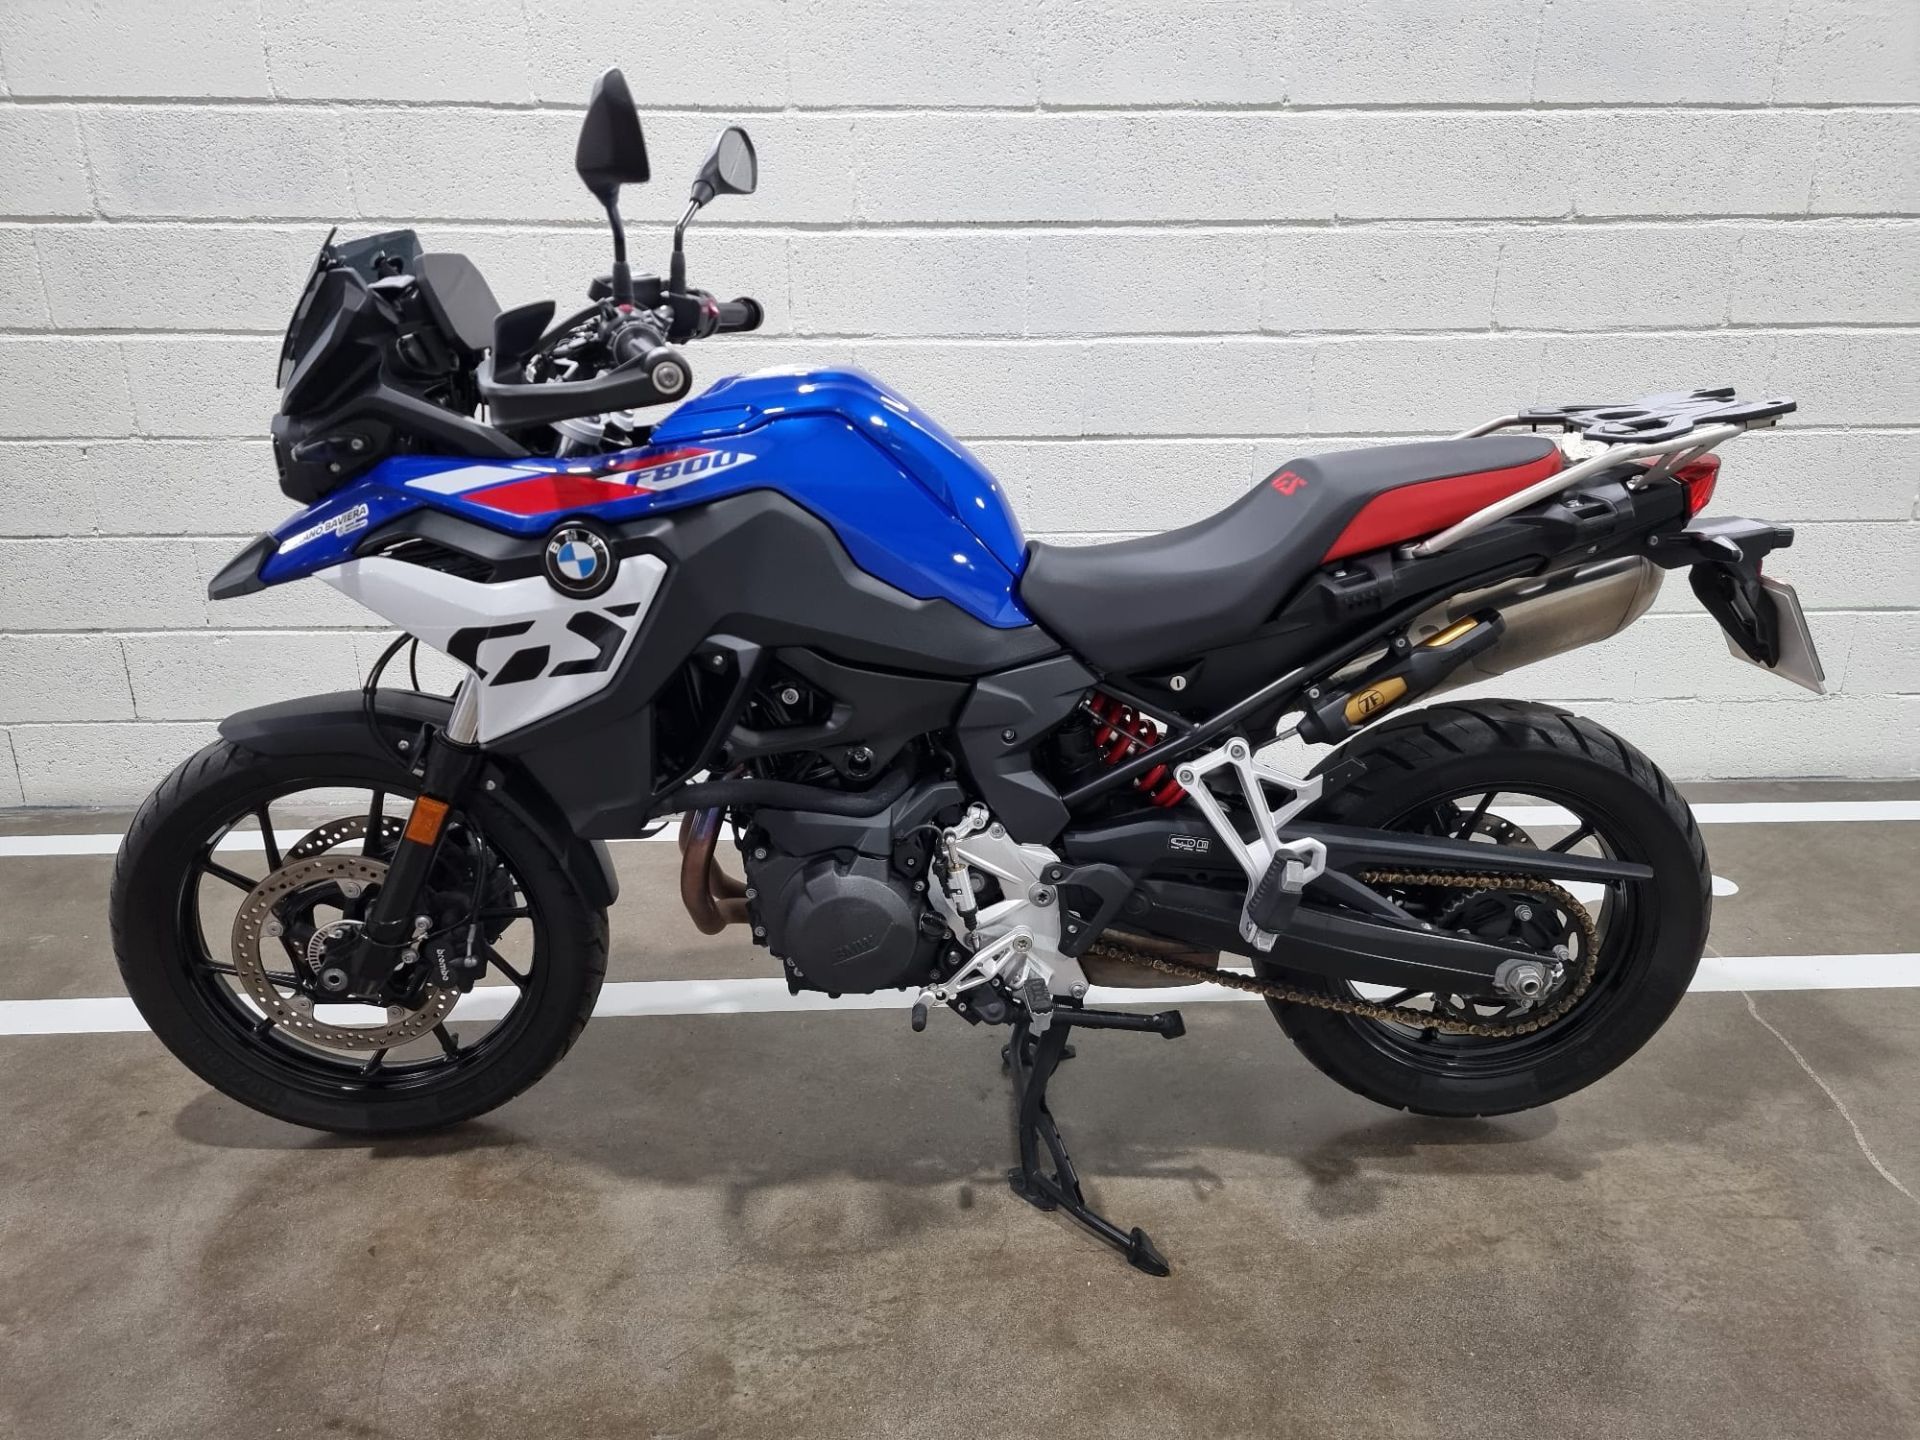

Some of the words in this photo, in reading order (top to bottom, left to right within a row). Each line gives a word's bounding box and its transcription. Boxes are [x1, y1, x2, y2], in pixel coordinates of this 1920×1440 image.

[625, 450, 738, 487] F800
[324, 505, 367, 532] BAVIERA
[549, 529, 606, 554] BMW
[447, 602, 641, 687] GS
[1359, 690, 1385, 713] ZF
[436, 948, 450, 981] brembo
